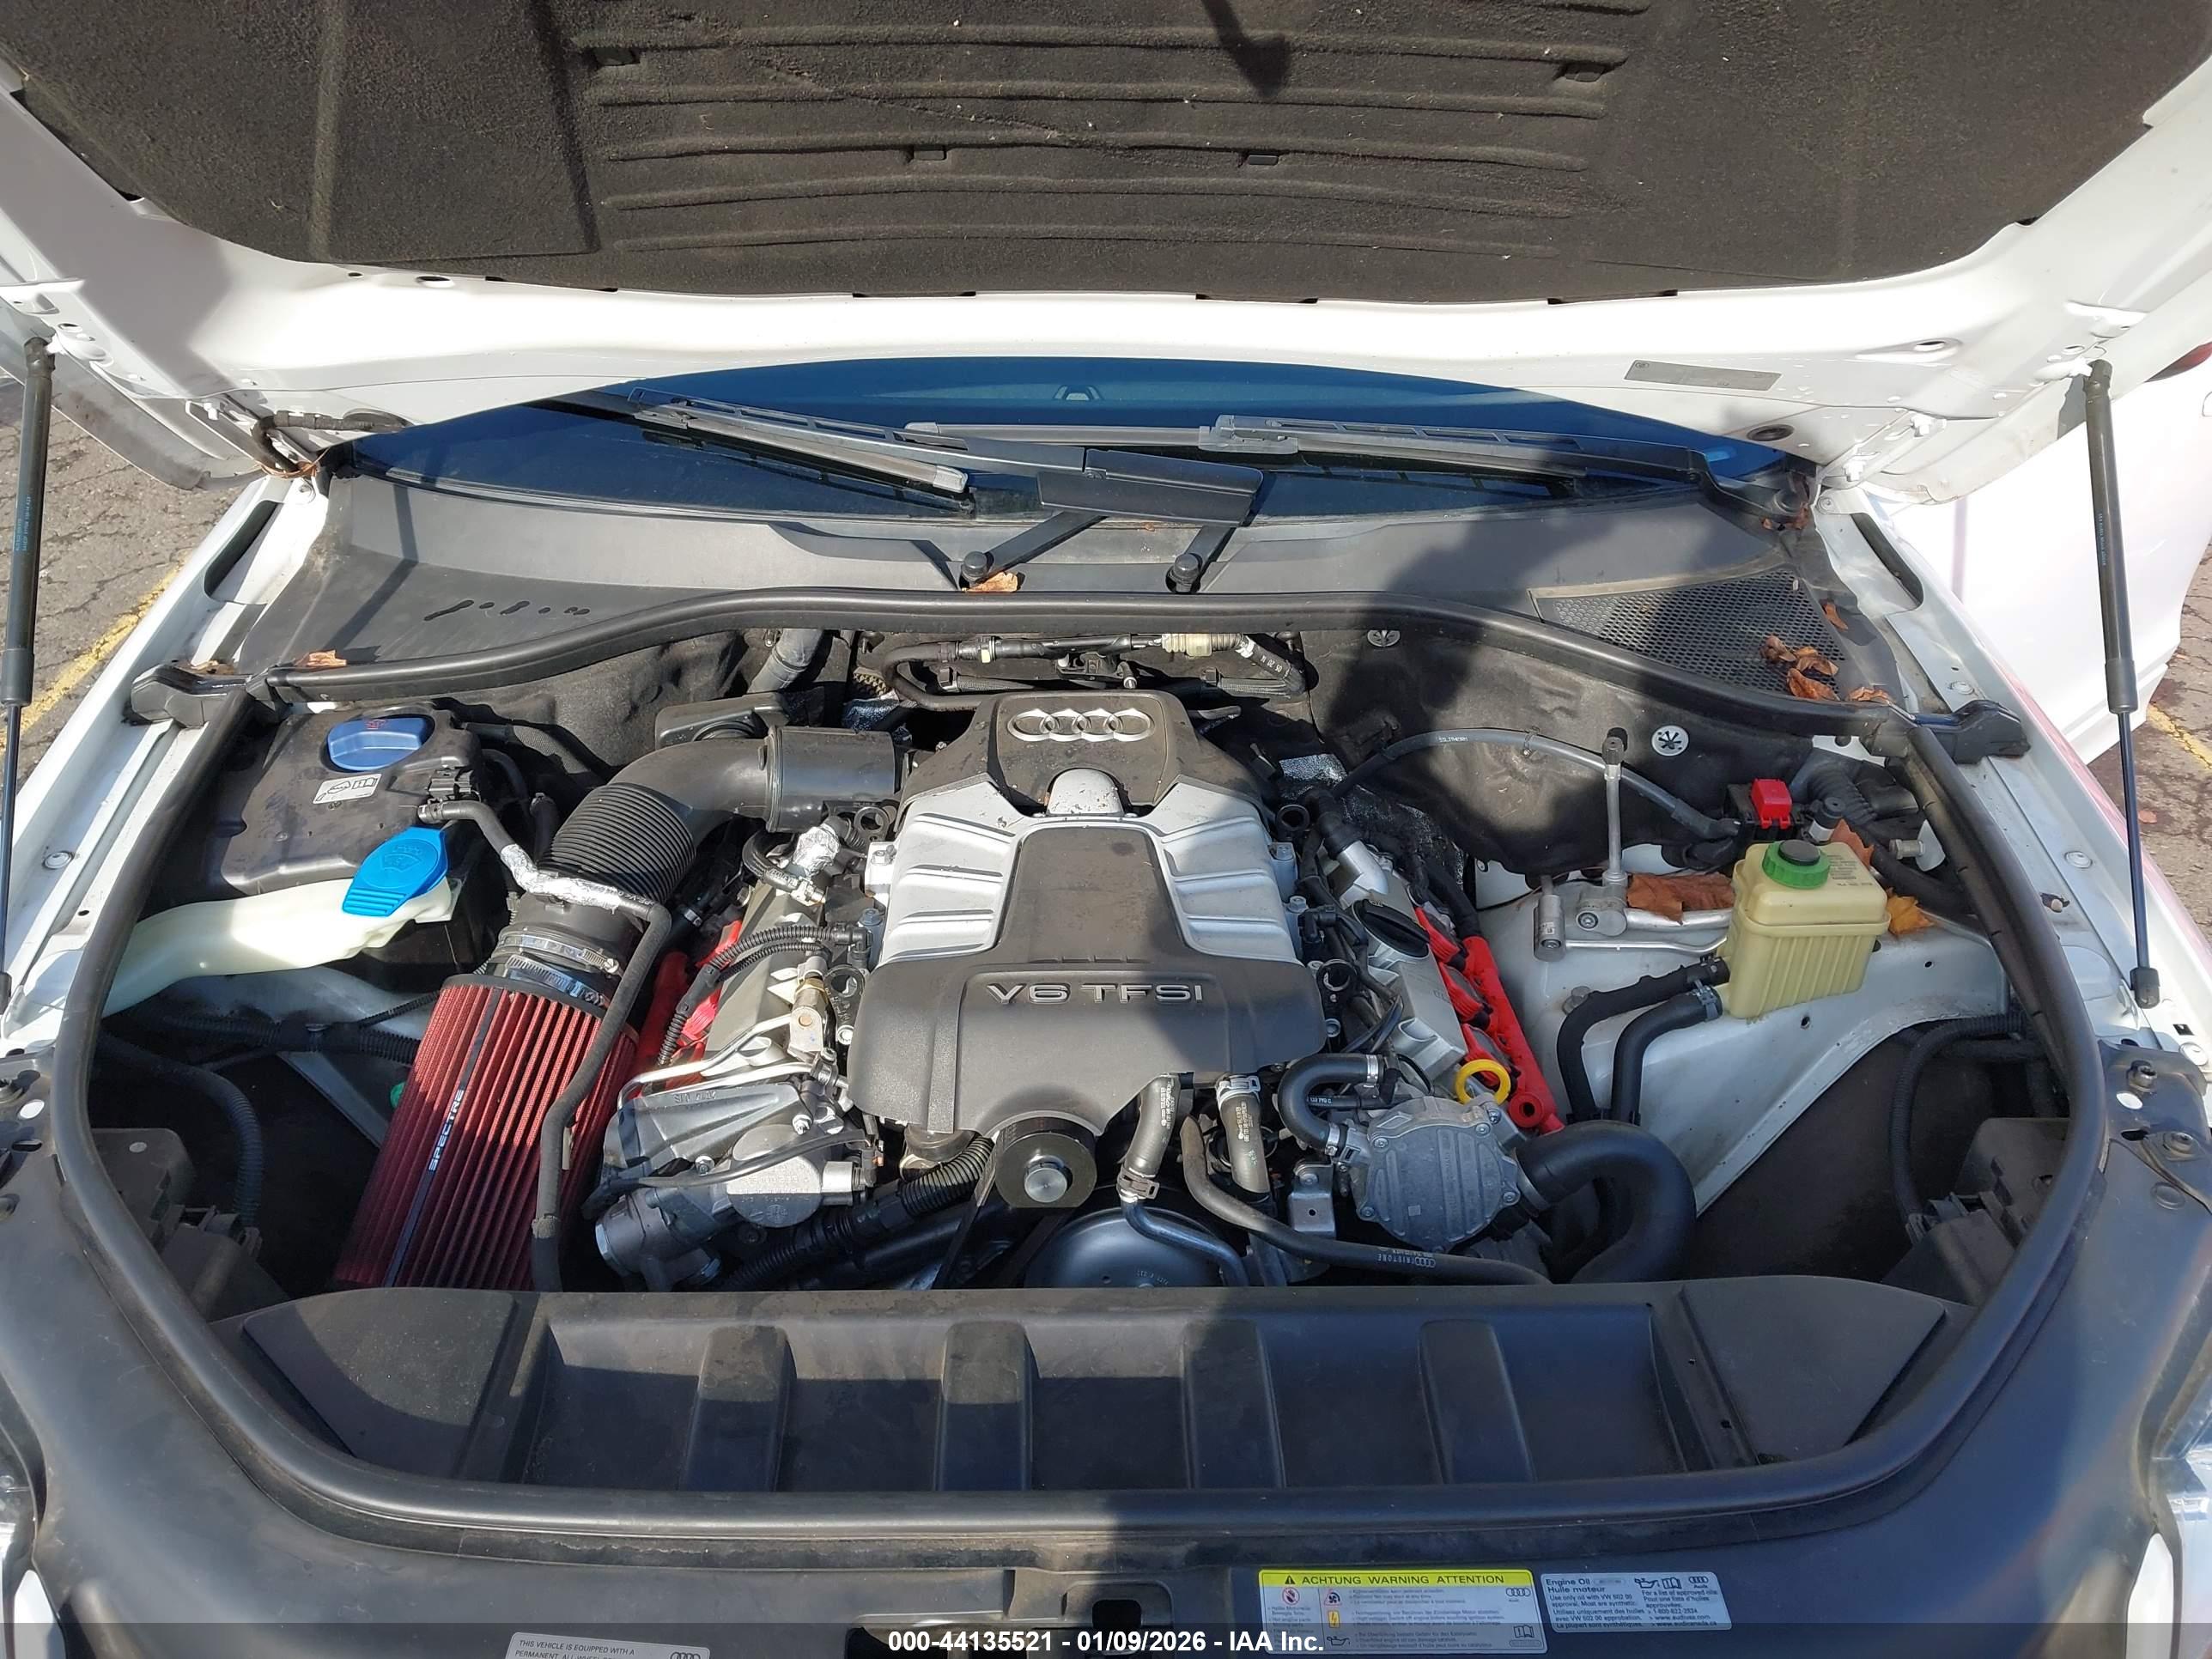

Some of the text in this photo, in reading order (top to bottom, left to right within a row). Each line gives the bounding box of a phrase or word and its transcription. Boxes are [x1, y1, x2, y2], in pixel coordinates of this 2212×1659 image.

[987, 984, 1203, 1004] V6 TFSI
[428, 1089, 465, 1171] SPECTRE
[1302, 1575, 1504, 1585] ACHTUNG WARNING ATTENTION
[1546, 1579, 1576, 1587] Engine
[536, 1641, 564, 1650] VEHICLE
[574, 1644, 609, 1653] EQUIPPED
[515, 1650, 559, 1659] PERMANENT
